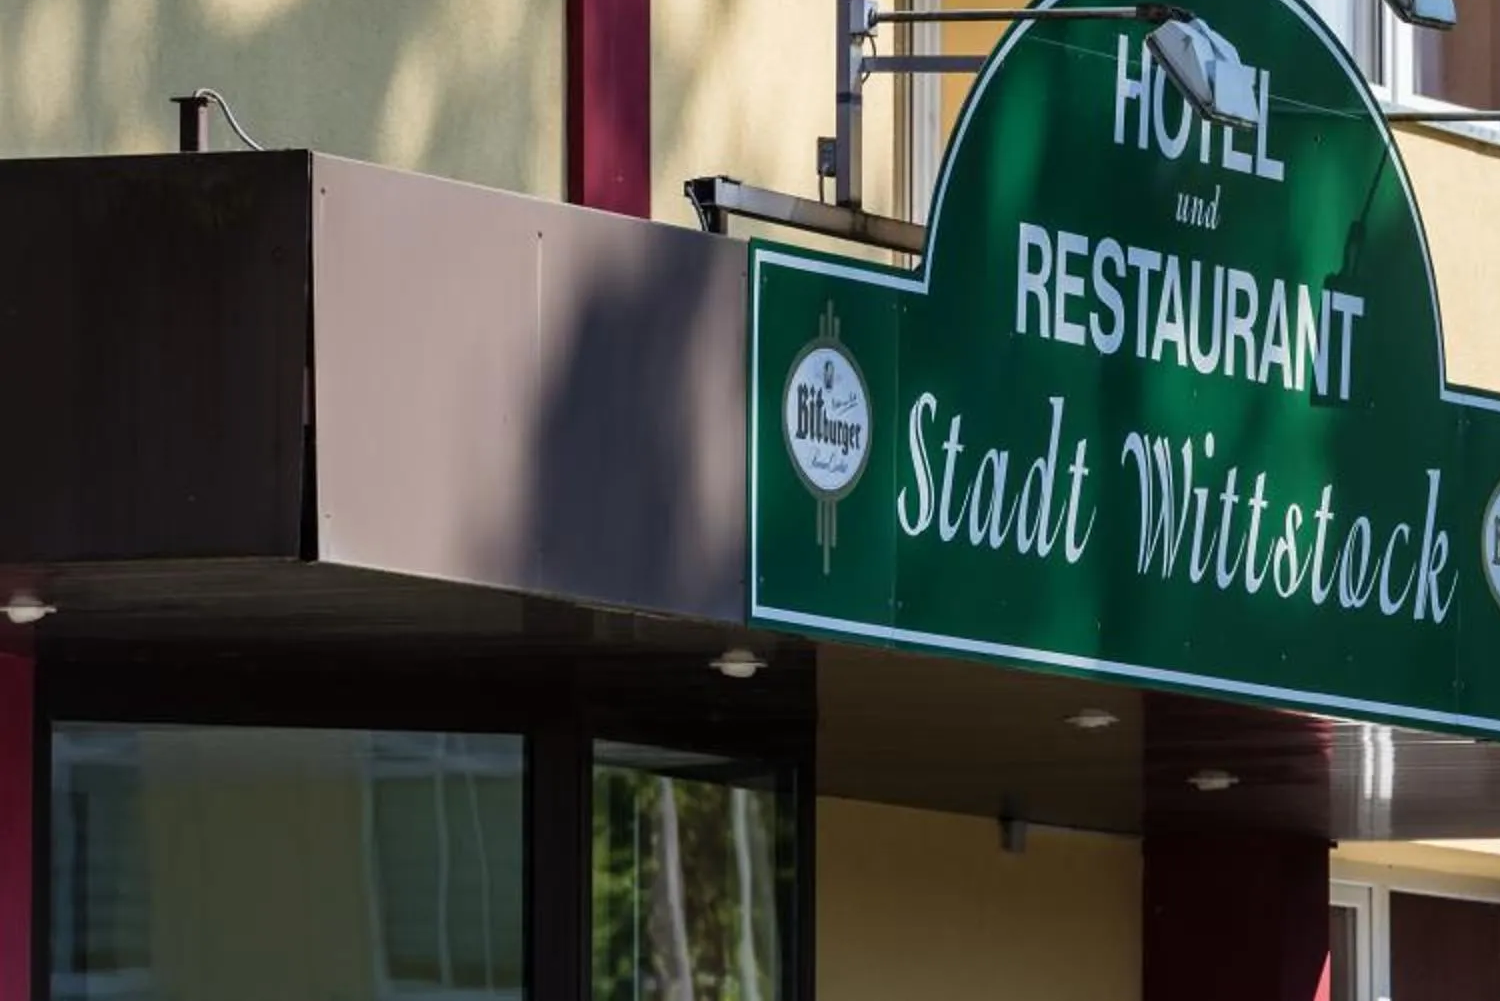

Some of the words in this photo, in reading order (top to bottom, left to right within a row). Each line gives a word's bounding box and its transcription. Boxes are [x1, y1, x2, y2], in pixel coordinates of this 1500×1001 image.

[1175, 184, 1221, 230] und
[1015, 222, 1365, 400] RESTAURANT
[795, 382, 862, 456] Bitburger
[897, 392, 1097, 564] Stadt
[1121, 432, 1458, 624] Wittstock
